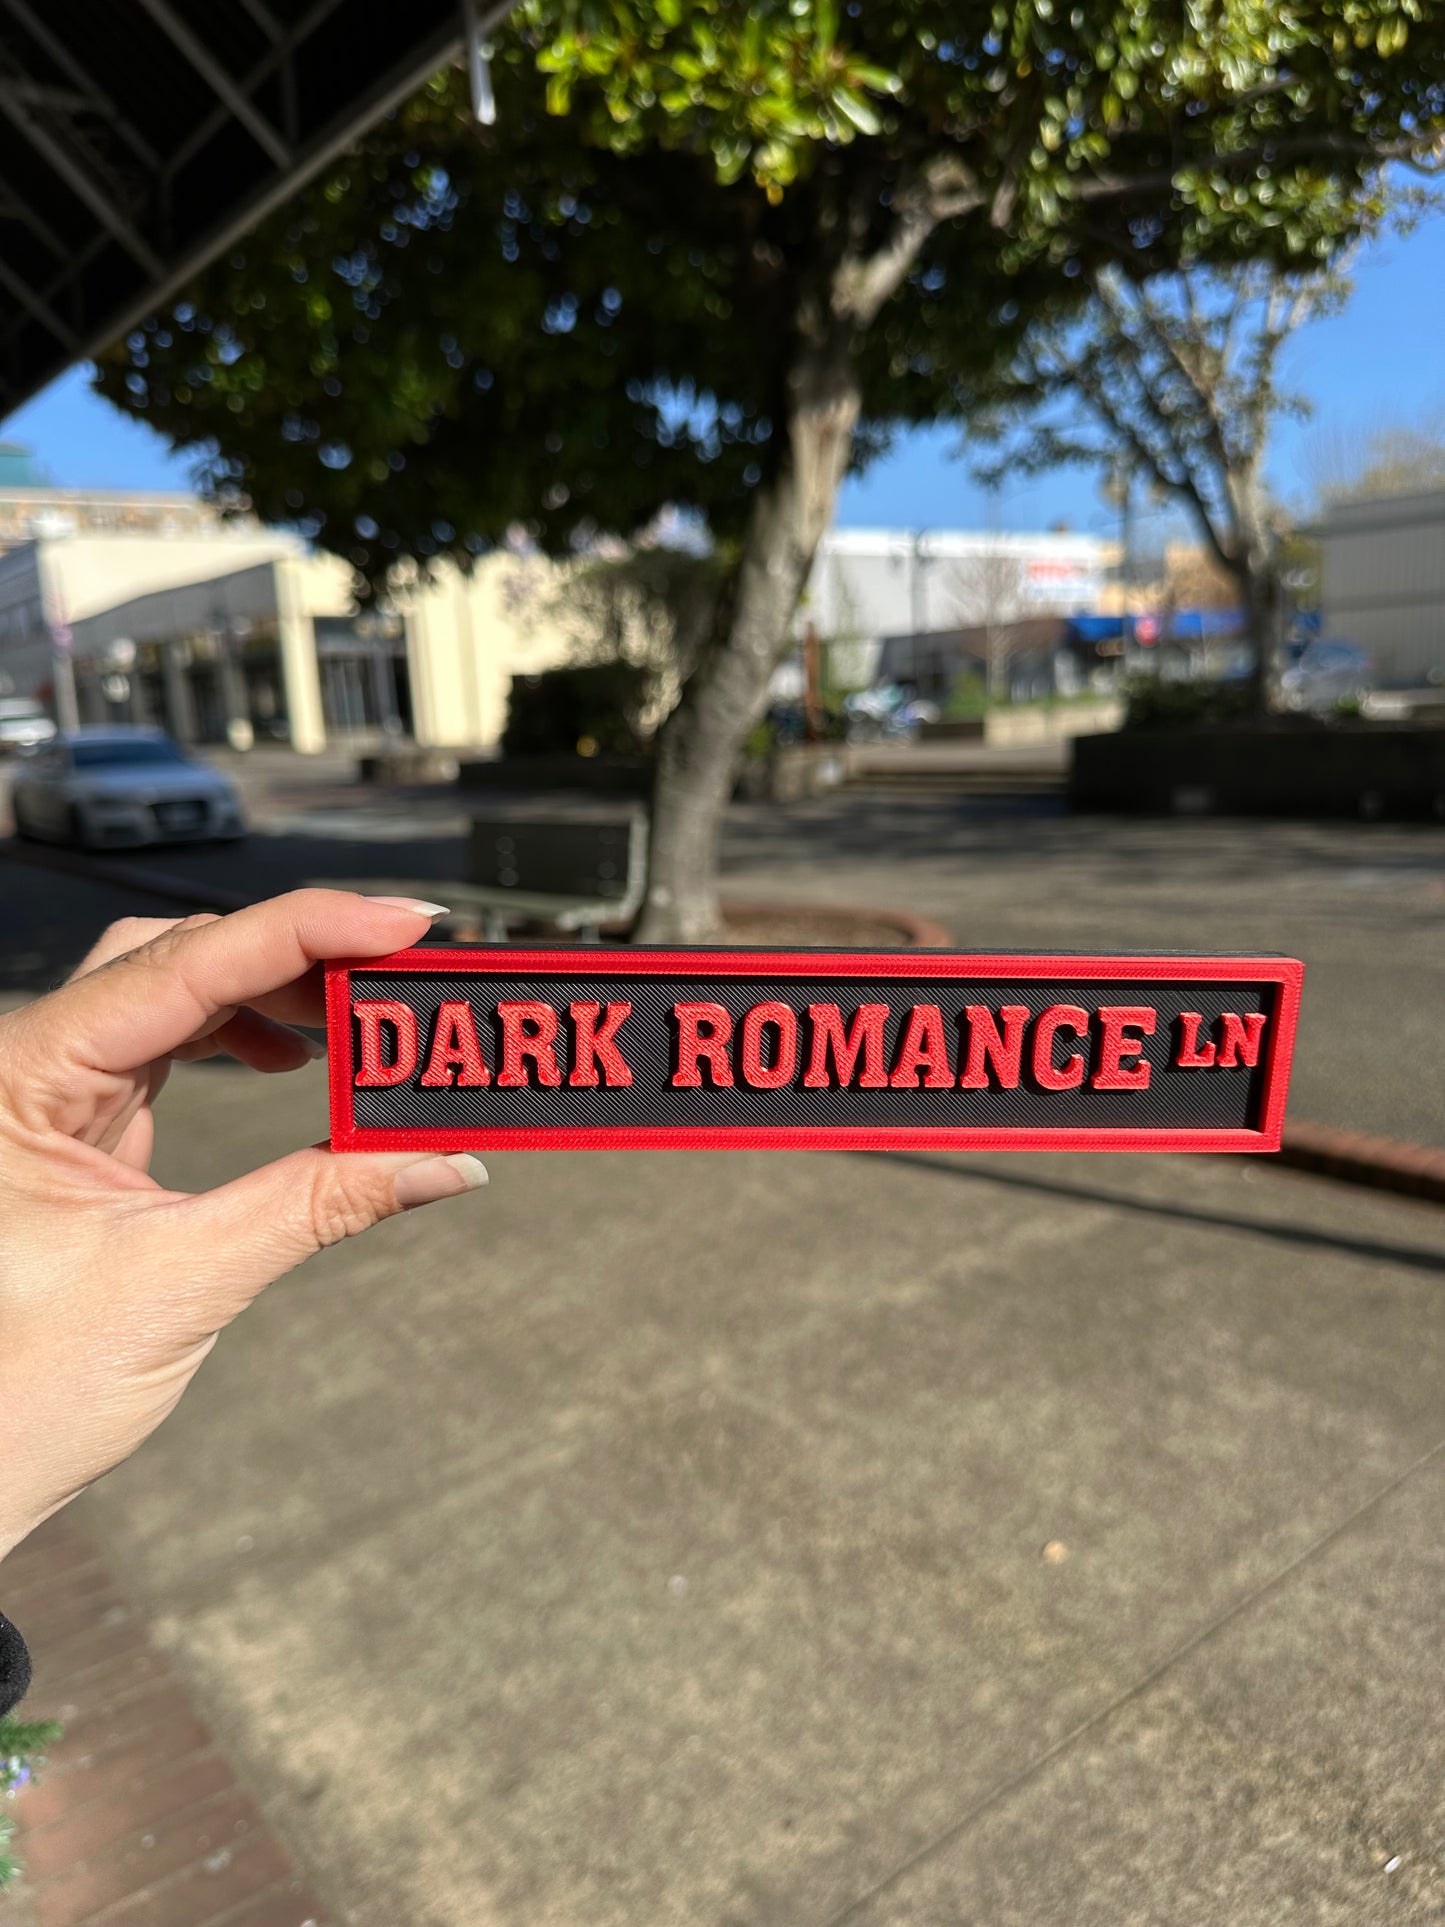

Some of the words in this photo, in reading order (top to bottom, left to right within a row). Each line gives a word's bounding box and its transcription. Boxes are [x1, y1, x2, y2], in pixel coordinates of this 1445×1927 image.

[353, 999, 633, 1088] DARK
[671, 1000, 1157, 1090] ROMANCE
[1175, 1011, 1267, 1068] LN
